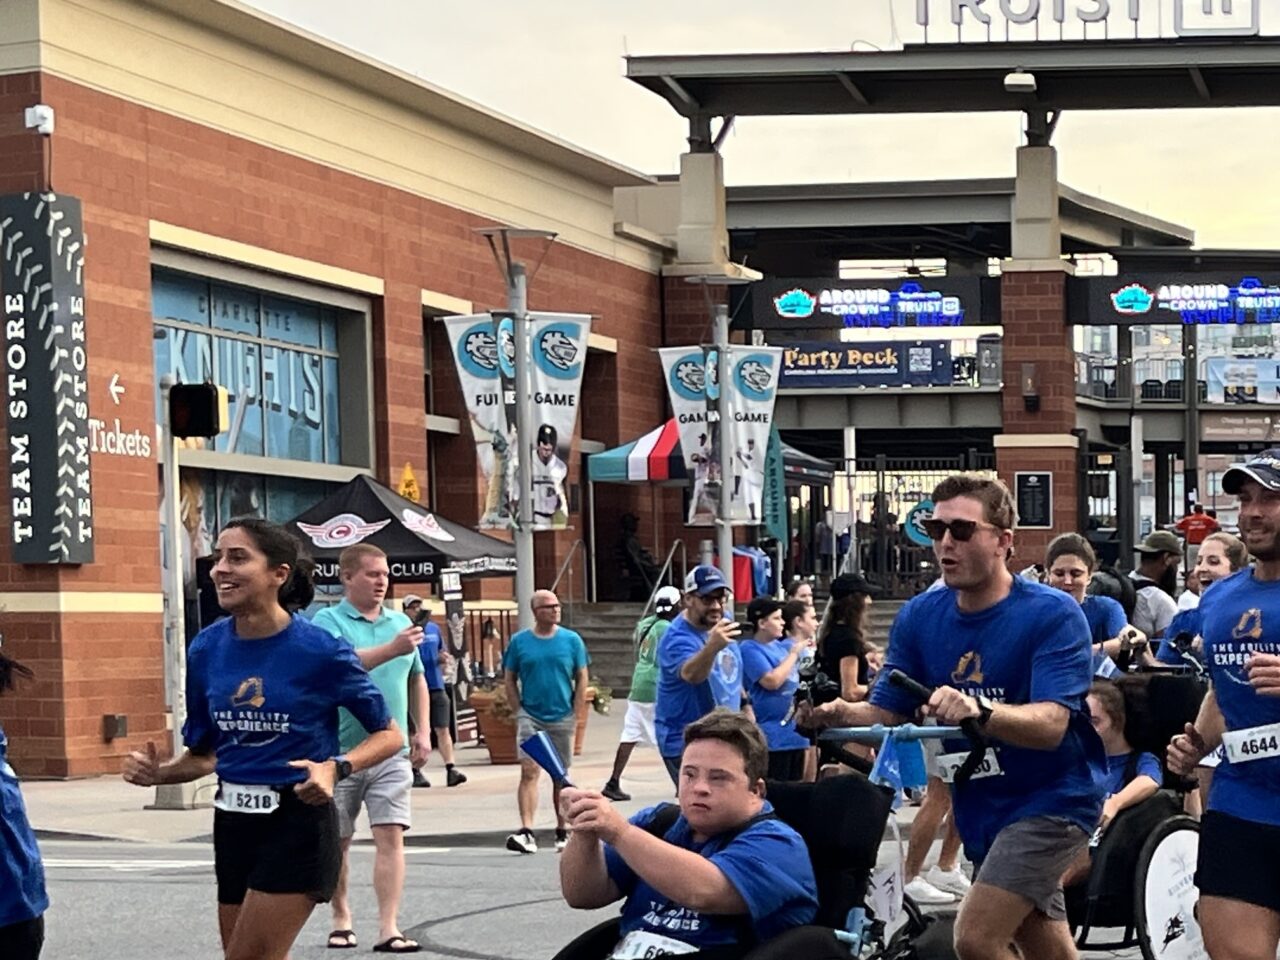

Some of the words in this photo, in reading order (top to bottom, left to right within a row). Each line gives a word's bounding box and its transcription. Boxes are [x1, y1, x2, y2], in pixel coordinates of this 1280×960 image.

[819, 289, 891, 304] AROUND
[1157, 284, 1230, 299] AROUND
[898, 301, 943, 313] TRUIST
[1169, 299, 1218, 311] CROWN
[5, 294, 28, 419] STORE
[70, 295, 88, 420] STORE
[784, 349, 843, 369] Party
[847, 348, 899, 366] Deck
[167, 318, 322, 430] KNIGHTS
[533, 392, 576, 407] GAME
[734, 411, 770, 424] GAME
[88, 418, 151, 458] Tickets
[11, 434, 33, 543] TEAM
[75, 435, 92, 544] TEAM
[390, 561, 434, 578] CLUB
[1212, 642, 1233, 653] THE
[213, 710, 233, 720] THE
[238, 710, 290, 721] ABILITY
[216, 720, 290, 733] EXPERIENCE
[1240, 735, 1279, 755] 4644
[236, 793, 272, 809] 5218
